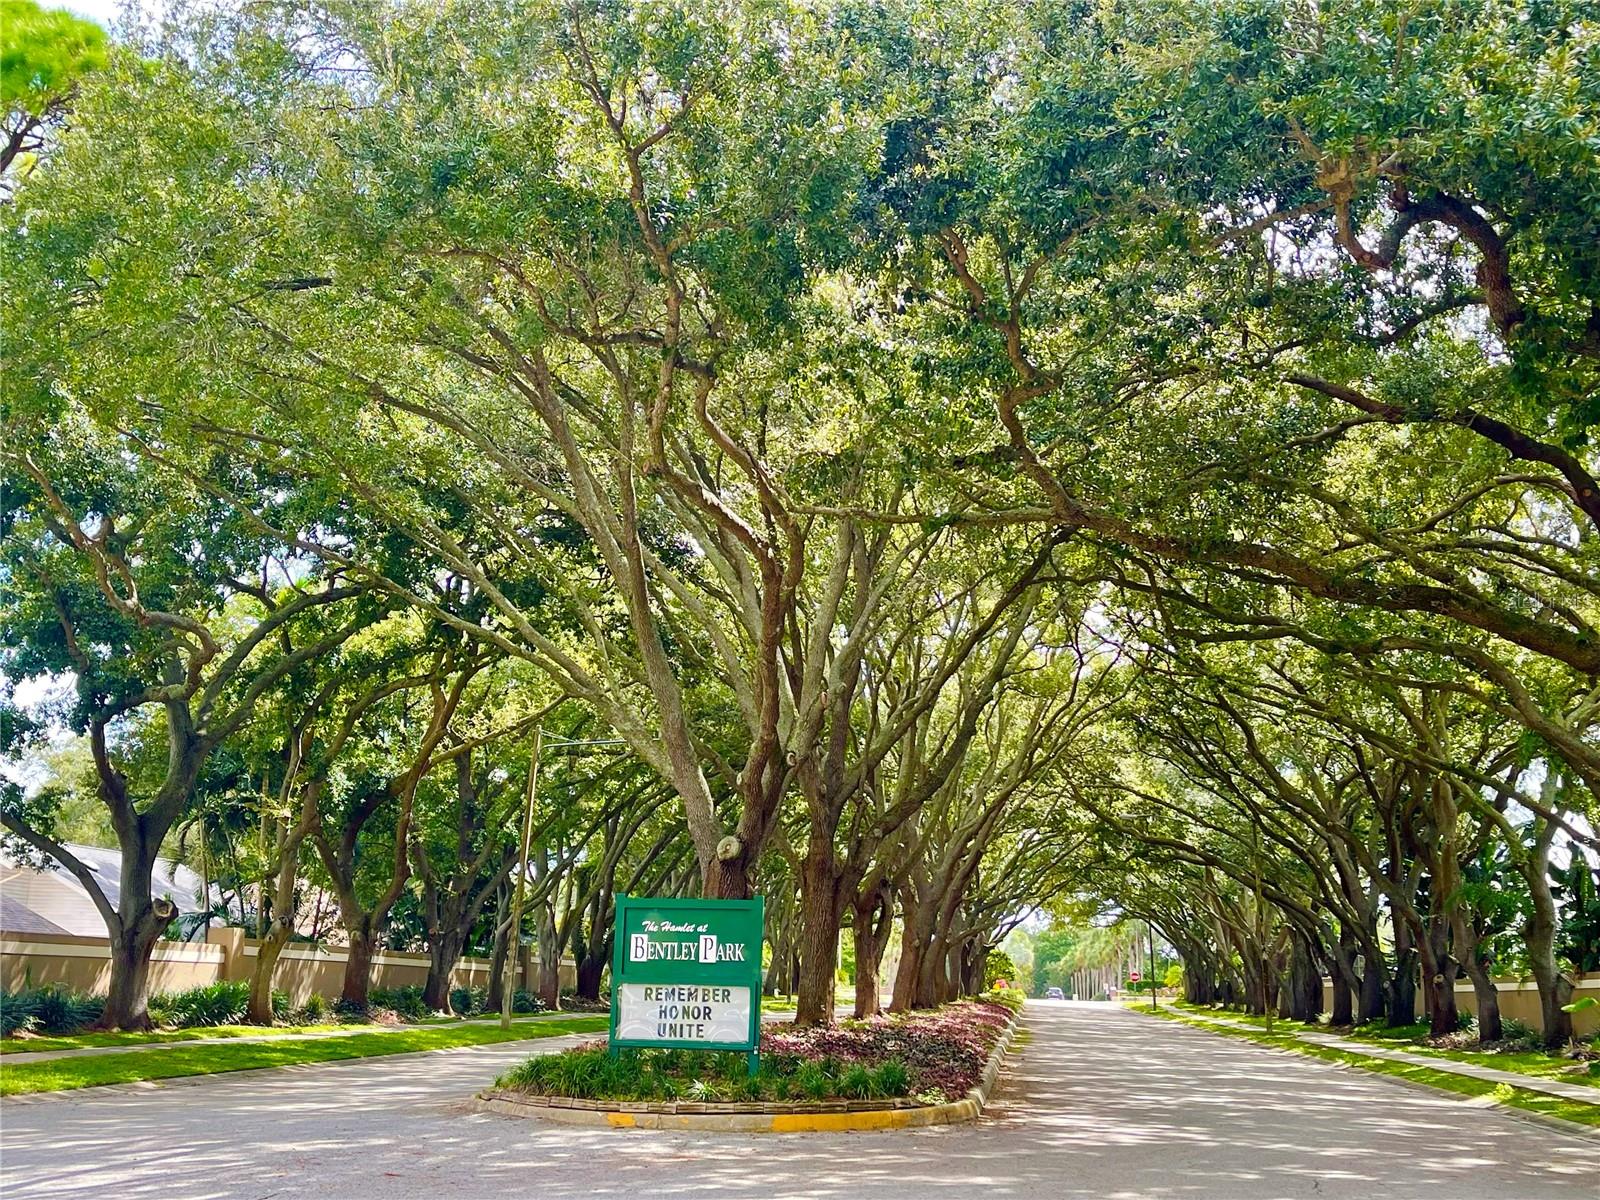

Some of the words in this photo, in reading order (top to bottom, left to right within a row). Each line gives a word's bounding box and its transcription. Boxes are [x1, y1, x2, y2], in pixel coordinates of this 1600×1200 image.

[641, 920, 658, 932] The
[660, 921, 695, 932] Hamlet
[697, 923, 709, 932] at
[633, 935, 698, 962] BENTLEY
[702, 936, 745, 963] PARK
[644, 987, 731, 1003] REMEMBER
[658, 1005, 712, 1021] HONOR
[657, 1023, 705, 1039] UNITE
